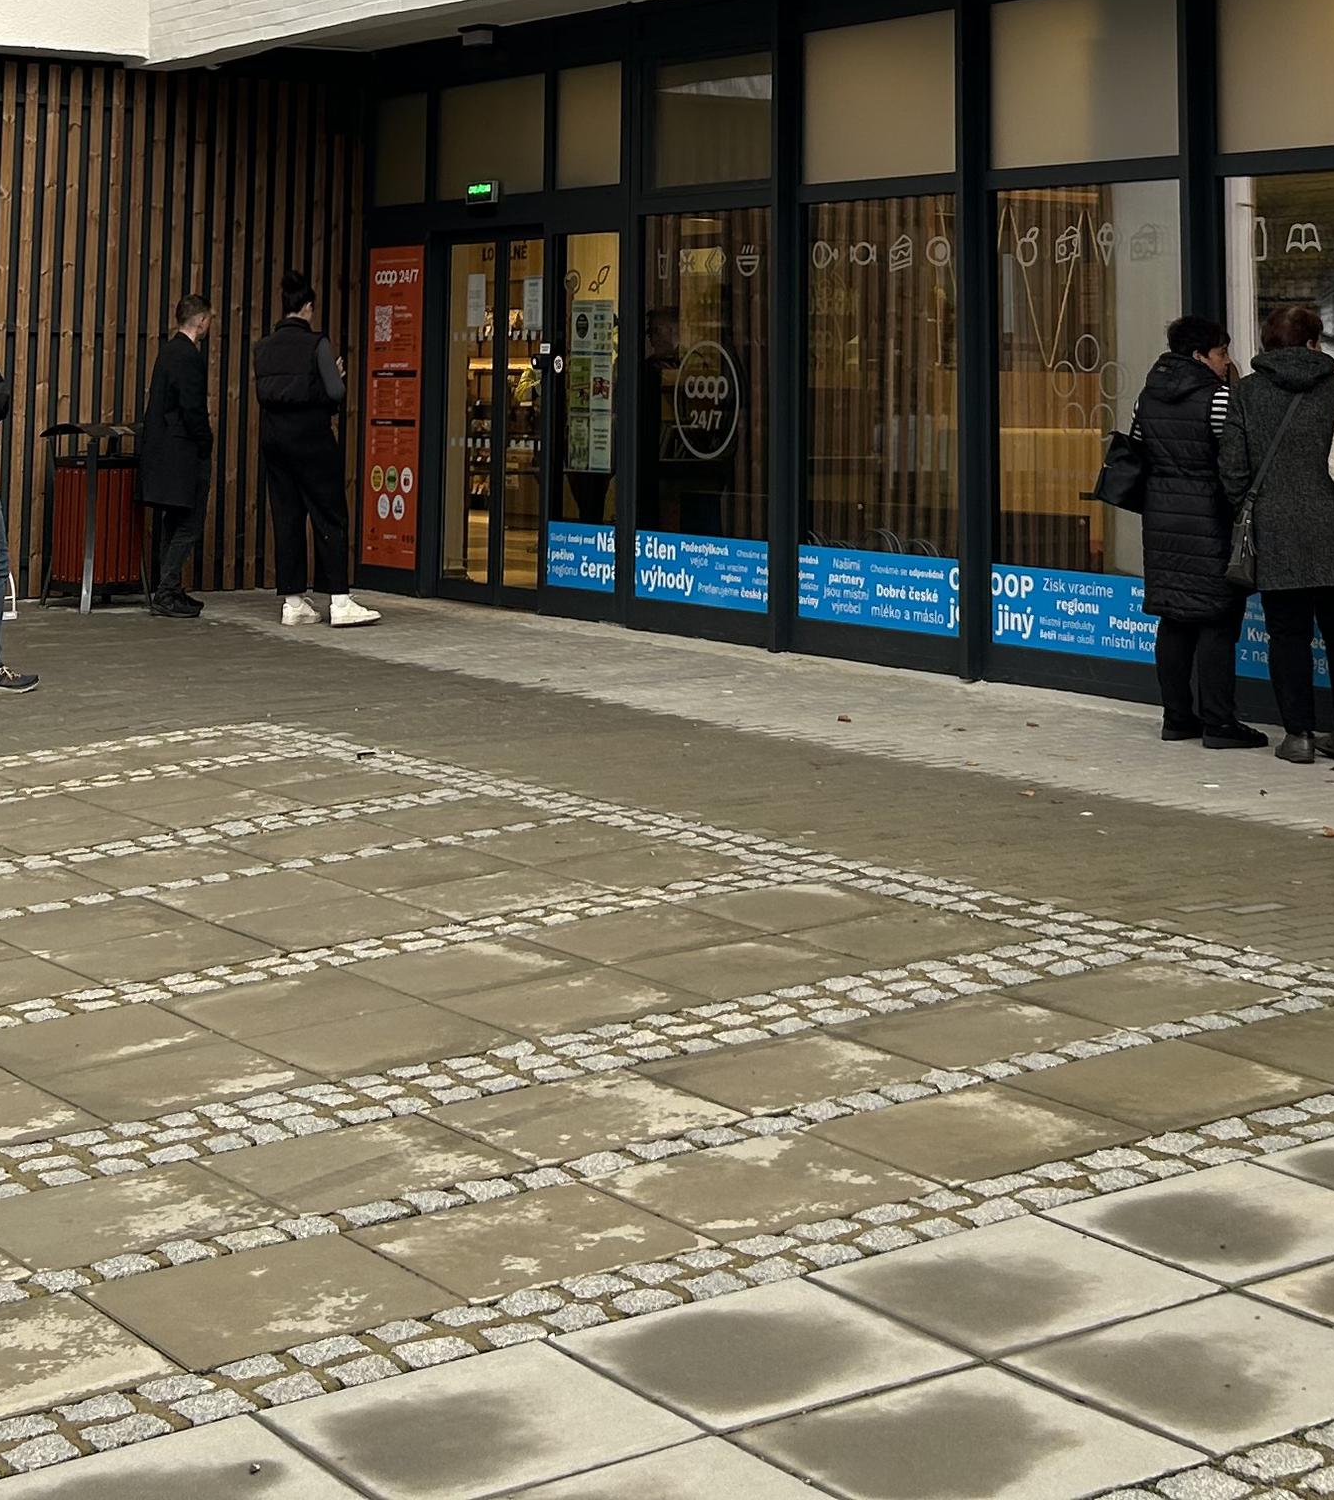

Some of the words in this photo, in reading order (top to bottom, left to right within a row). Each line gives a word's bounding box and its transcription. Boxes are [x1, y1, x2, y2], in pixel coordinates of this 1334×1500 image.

[398, 268, 419, 284] 24/7
[685, 376, 728, 405] coop
[690, 409, 722, 431] 24/7
[645, 535, 676, 560] člen
[832, 557, 861, 572] Našimi
[870, 563, 899, 576] Chováme
[640, 564, 694, 596] výhody
[828, 572, 866, 589] partnery
[1042, 577, 1066, 593] Zisk
[1067, 580, 1114, 599] vracíme
[823, 585, 842, 598] jsou
[876, 583, 907, 599] Dobré
[908, 586, 939, 604] české
[831, 600, 862, 615] výrobci
[871, 603, 902, 621] mléko
[903, 609, 911, 622] a
[913, 609, 945, 626] máslo
[1056, 598, 1100, 617] regionu
[995, 603, 1035, 640] jiný
[1101, 635, 1136, 651] místní
